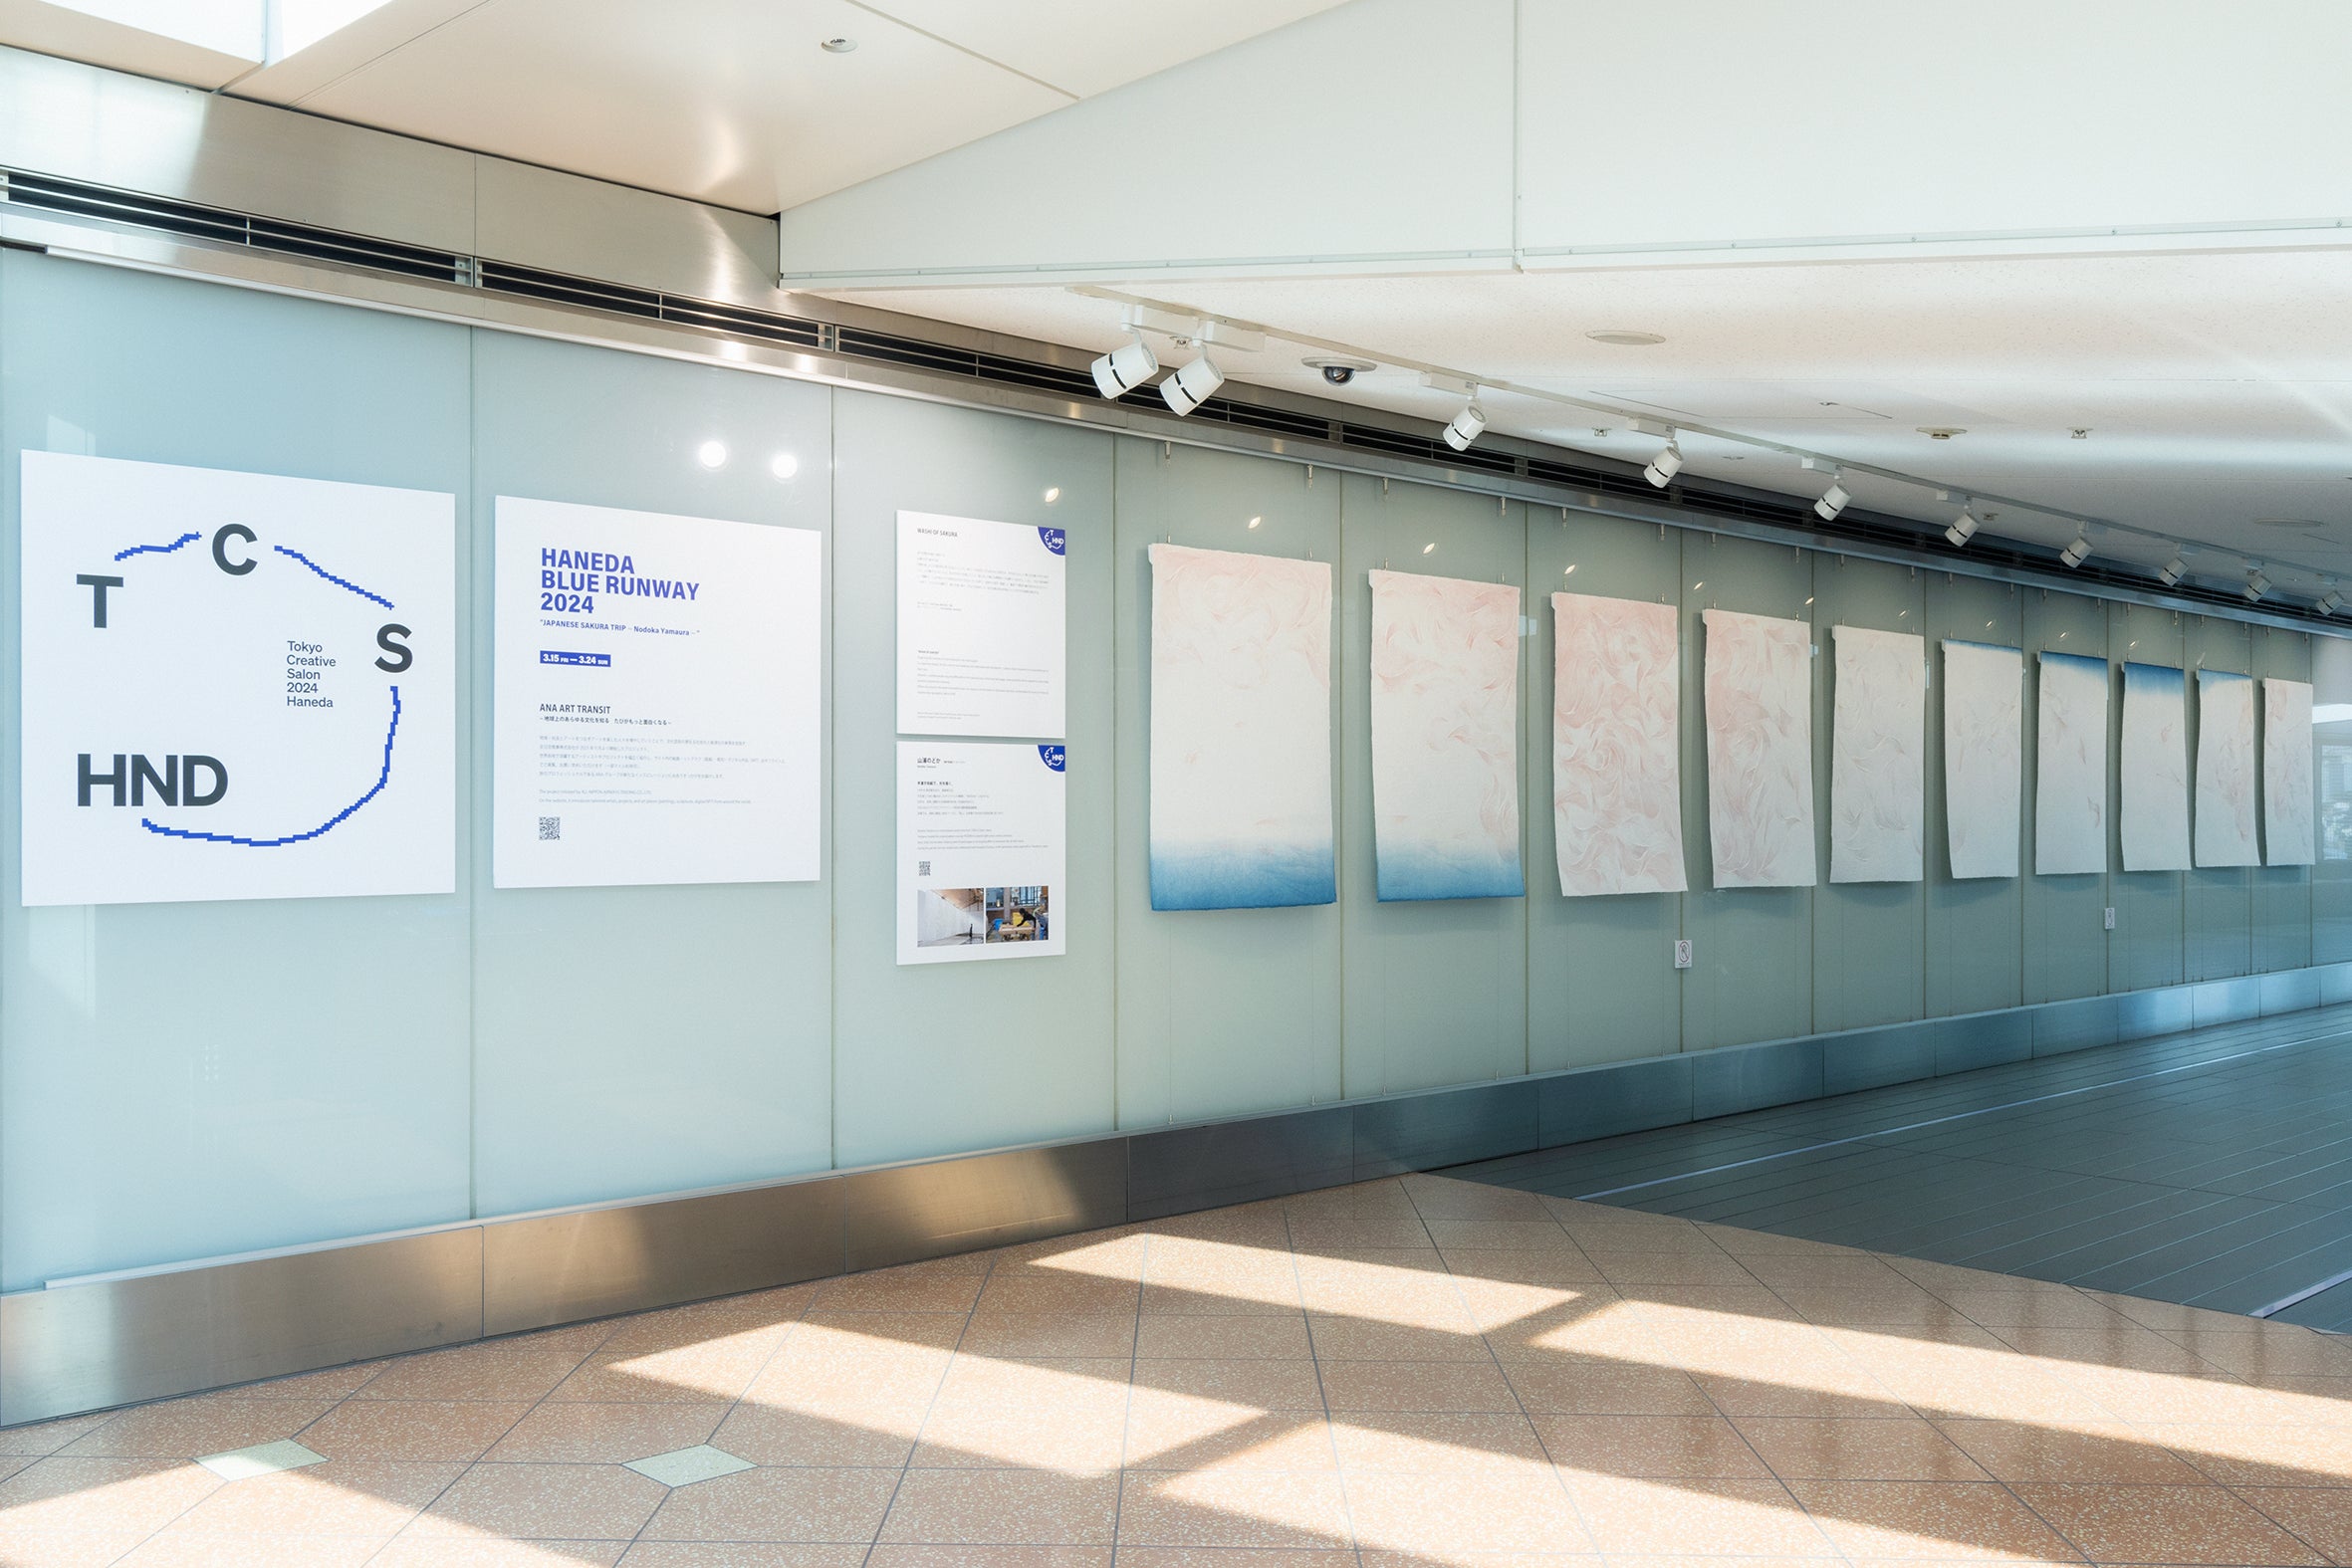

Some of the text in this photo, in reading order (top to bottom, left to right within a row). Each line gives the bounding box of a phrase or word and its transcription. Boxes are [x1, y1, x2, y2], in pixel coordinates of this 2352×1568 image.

[212, 523, 258, 576] C
[542, 548, 634, 574] HANEDA
[542, 569, 700, 600] BLUE RUNWAY
[77, 573, 124, 628] T
[541, 592, 594, 613] 2024
[287, 640, 324, 653] Tokyo
[374, 623, 413, 673] S
[287, 654, 337, 667] Creative
[543, 653, 560, 662] 3.15
[579, 655, 596, 664] 3.24
[287, 668, 321, 680] Salon
[287, 681, 319, 694] 2024
[287, 695, 334, 708] Haneda
[539, 703, 611, 715] ANA ART TRANSIT
[78, 754, 228, 807] HND
